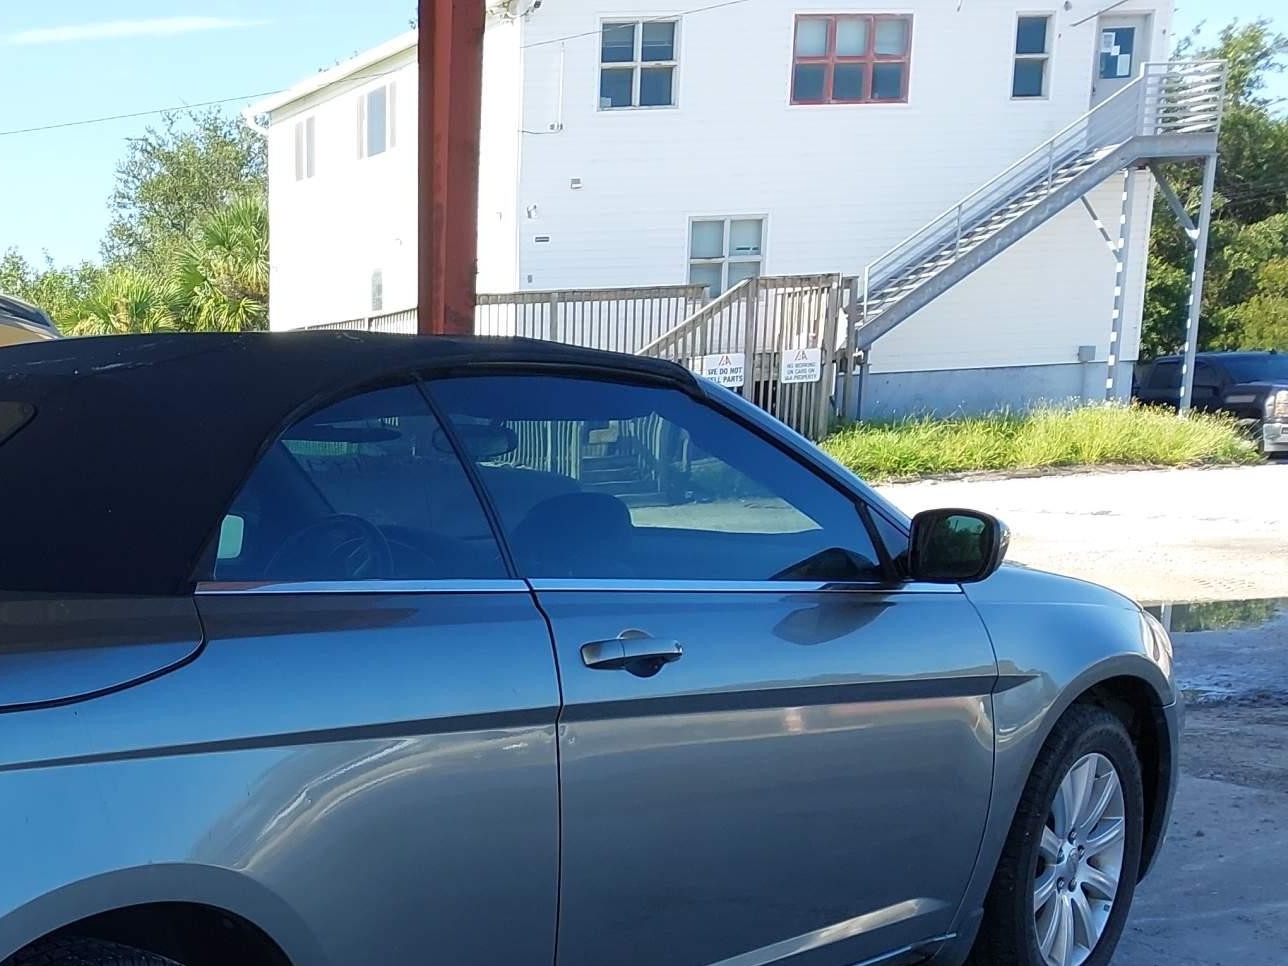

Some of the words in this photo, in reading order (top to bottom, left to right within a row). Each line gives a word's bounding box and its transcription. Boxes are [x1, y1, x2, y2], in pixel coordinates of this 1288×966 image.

[719, 367, 728, 375] DO
[730, 366, 743, 374] NOT
[722, 375, 743, 383] PARTS
